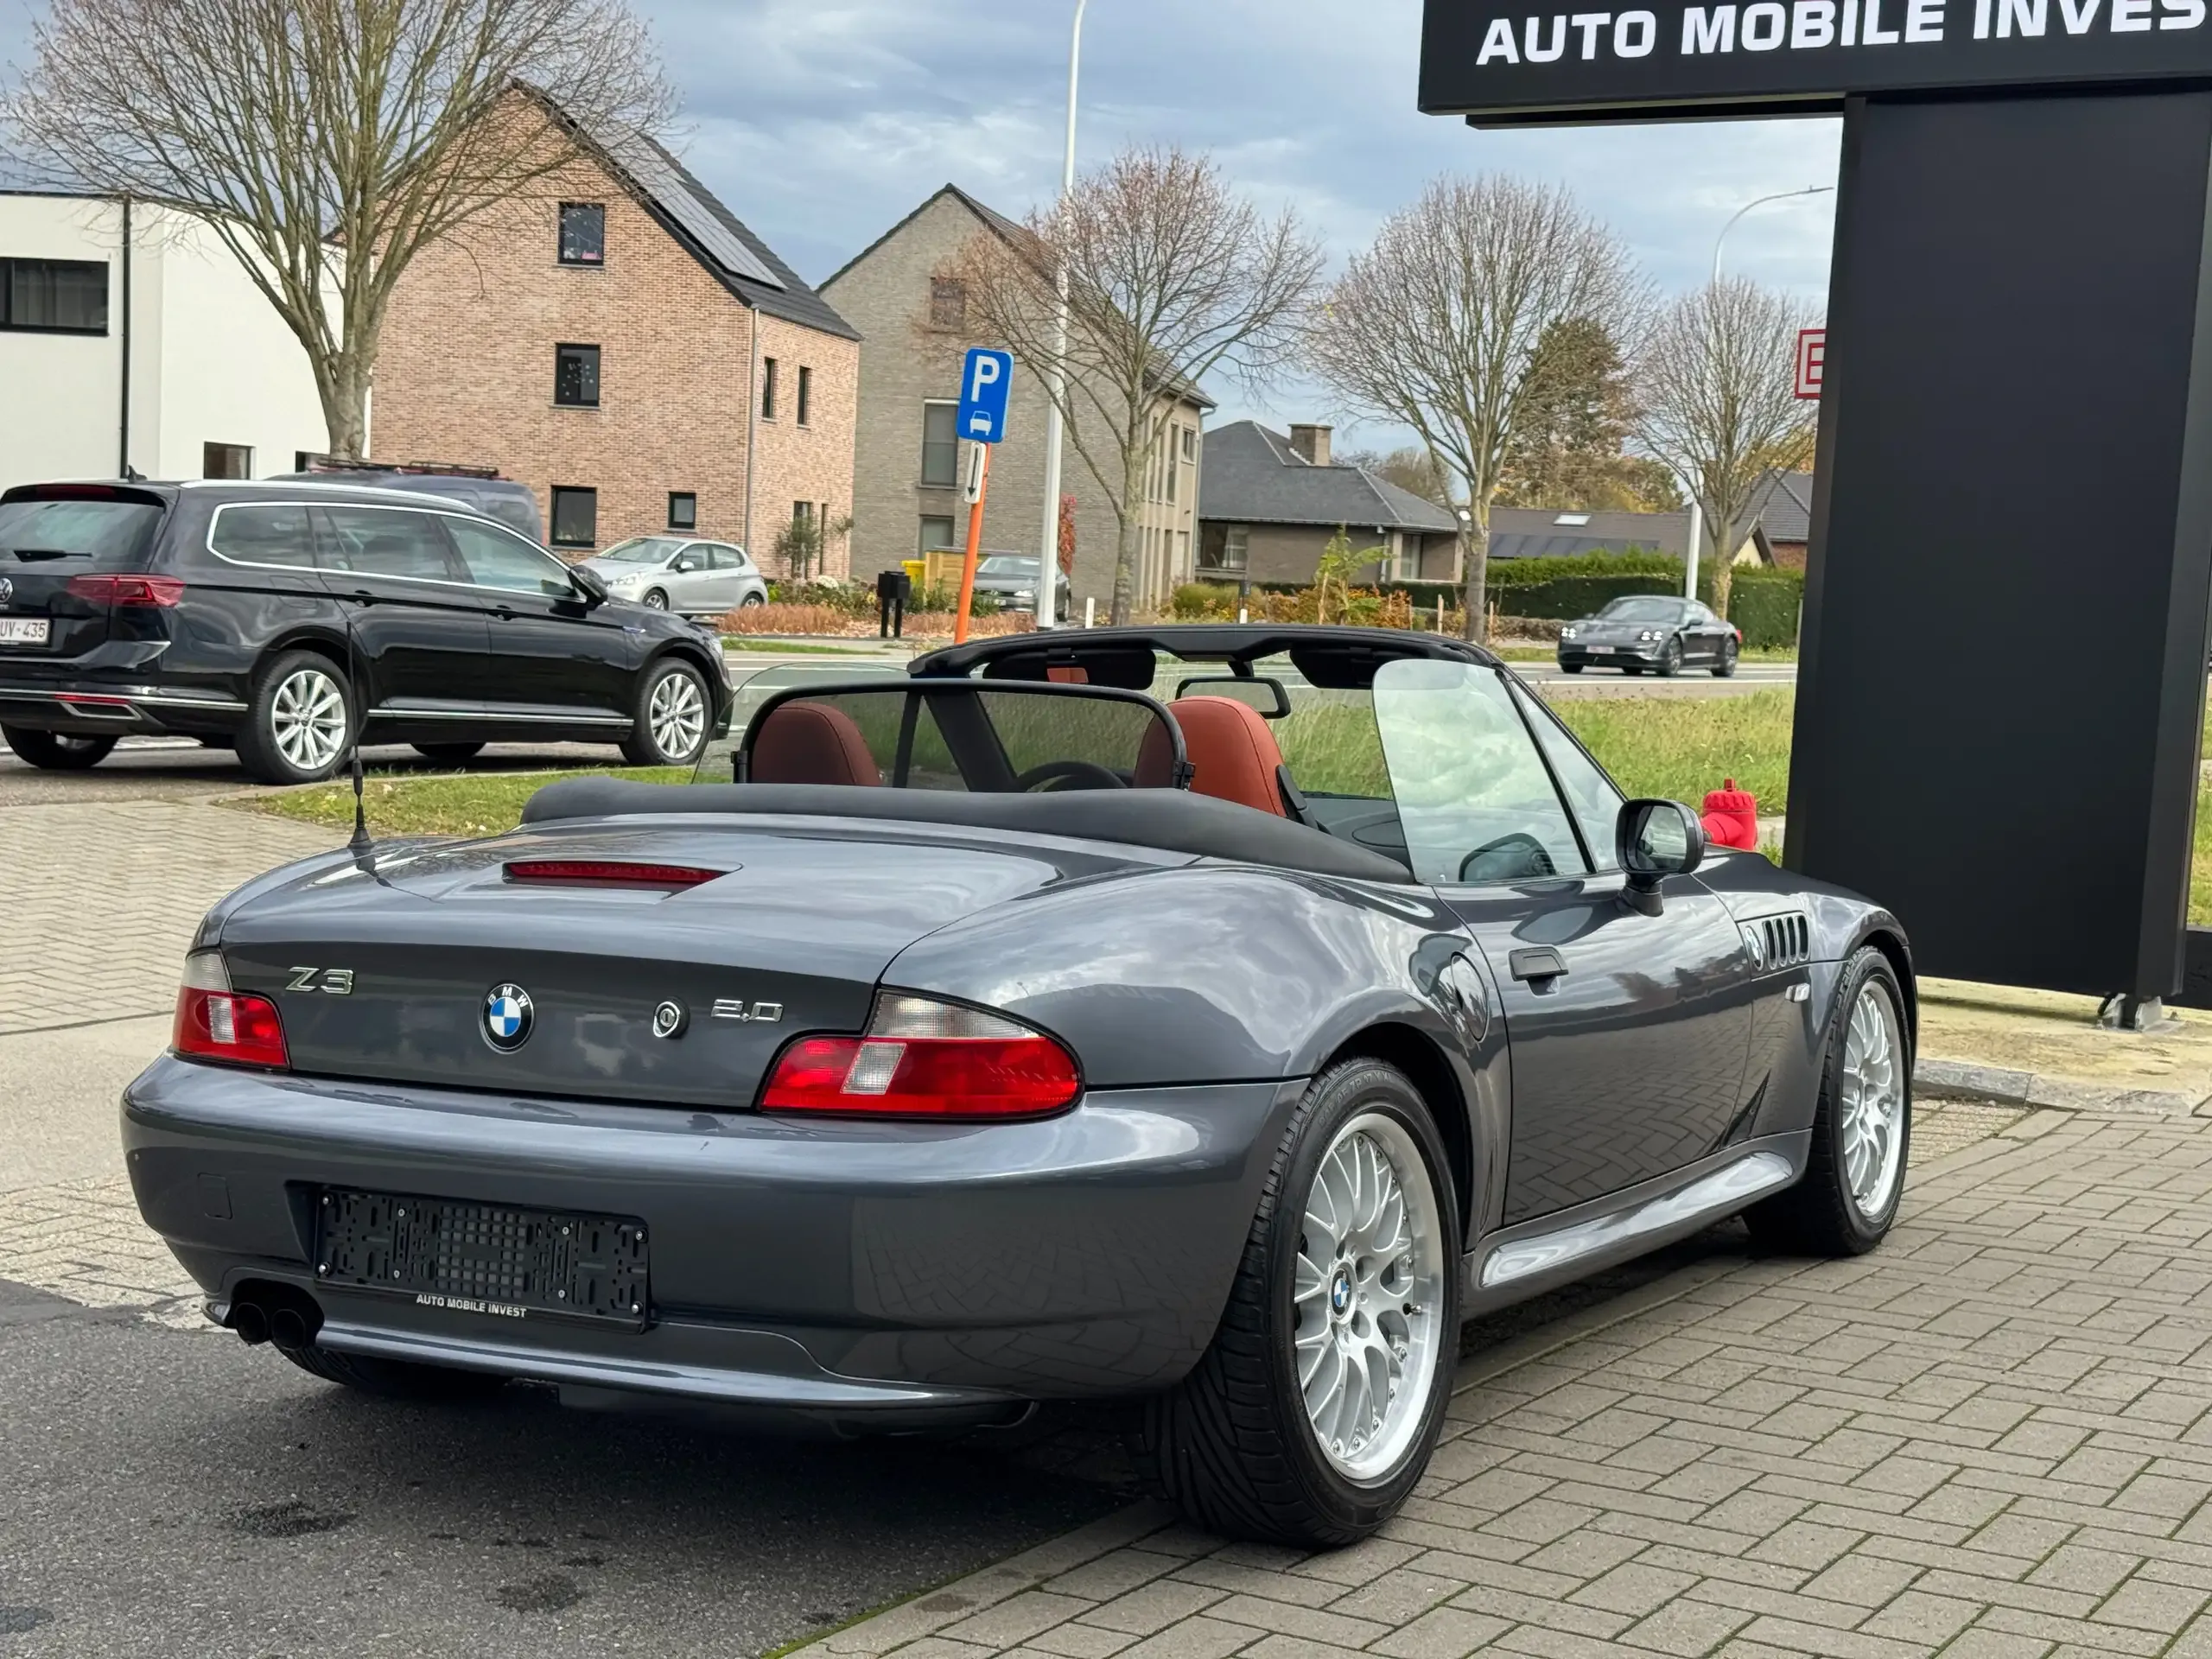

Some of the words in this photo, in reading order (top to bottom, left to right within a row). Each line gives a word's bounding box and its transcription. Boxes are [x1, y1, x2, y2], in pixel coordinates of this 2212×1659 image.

[1476, 10, 1656, 65] AUTO
[1680, 0, 1945, 54] MOBILE
[970, 355, 1001, 403] P
[285, 966, 353, 995] Z3
[487, 986, 529, 1008] BMW
[710, 999, 784, 1022] 2.0
[416, 1294, 444, 1306] AUTO
[447, 1298, 486, 1312] MOBILE
[487, 1303, 527, 1318] INVEST
